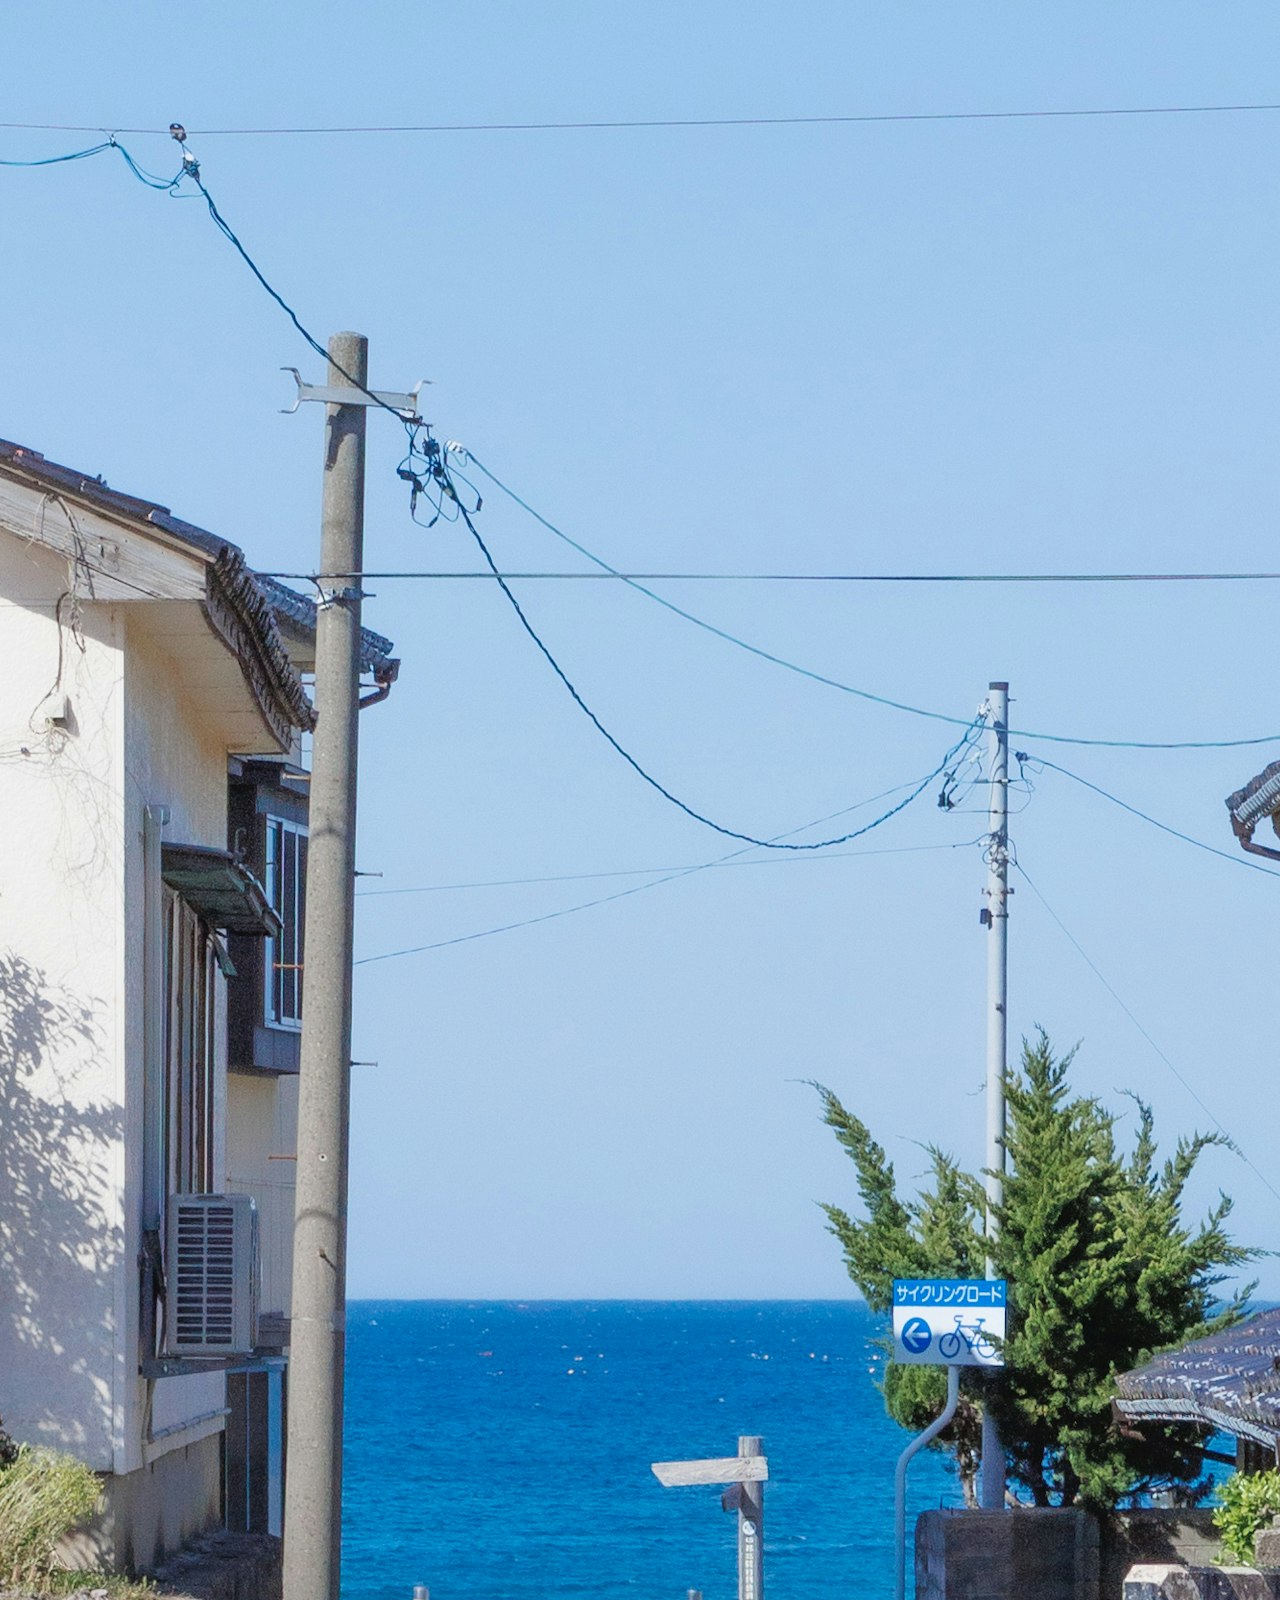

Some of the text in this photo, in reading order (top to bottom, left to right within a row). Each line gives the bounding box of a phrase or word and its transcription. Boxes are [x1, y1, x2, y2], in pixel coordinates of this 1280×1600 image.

[896, 1284, 1003, 1304] サイクリングロード
